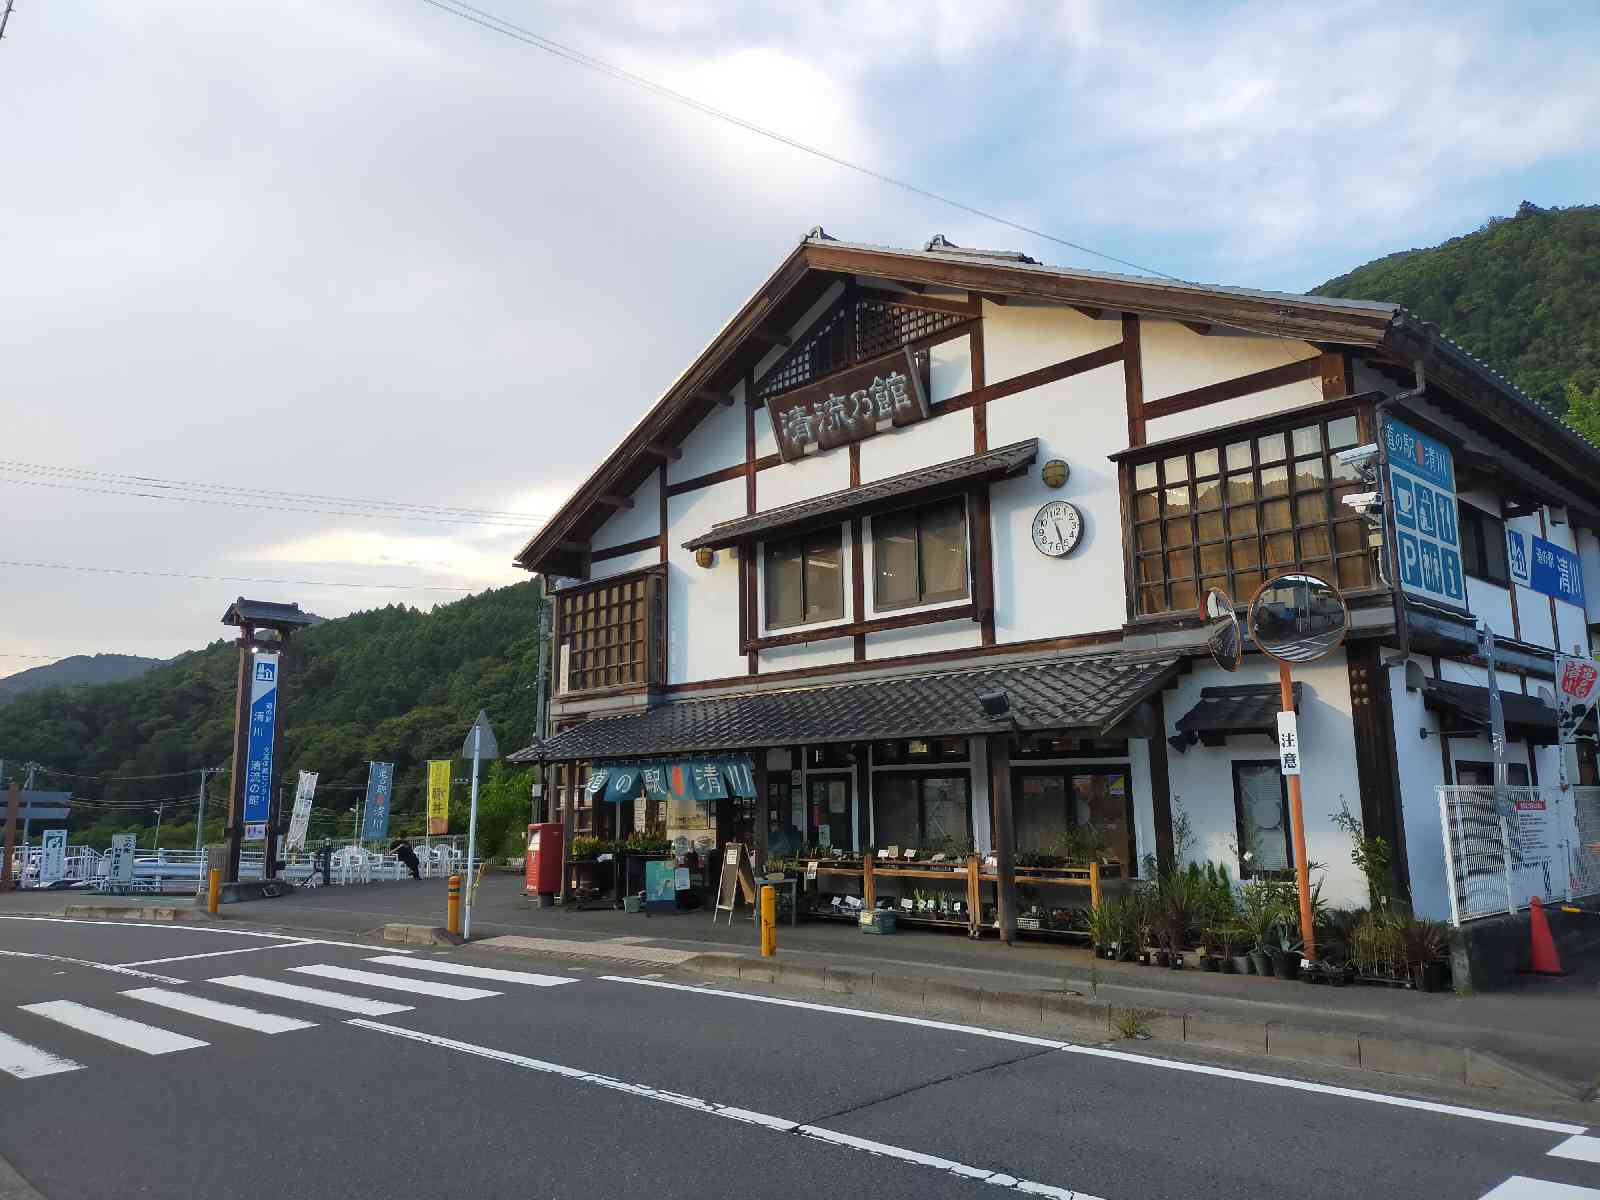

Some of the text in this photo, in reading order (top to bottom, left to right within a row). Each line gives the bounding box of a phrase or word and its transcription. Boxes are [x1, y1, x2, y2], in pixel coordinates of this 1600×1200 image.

[1403, 538, 1416, 580] P
[1281, 732, 1297, 769] 注意
[585, 763, 751, 794] 道の駅 清川
